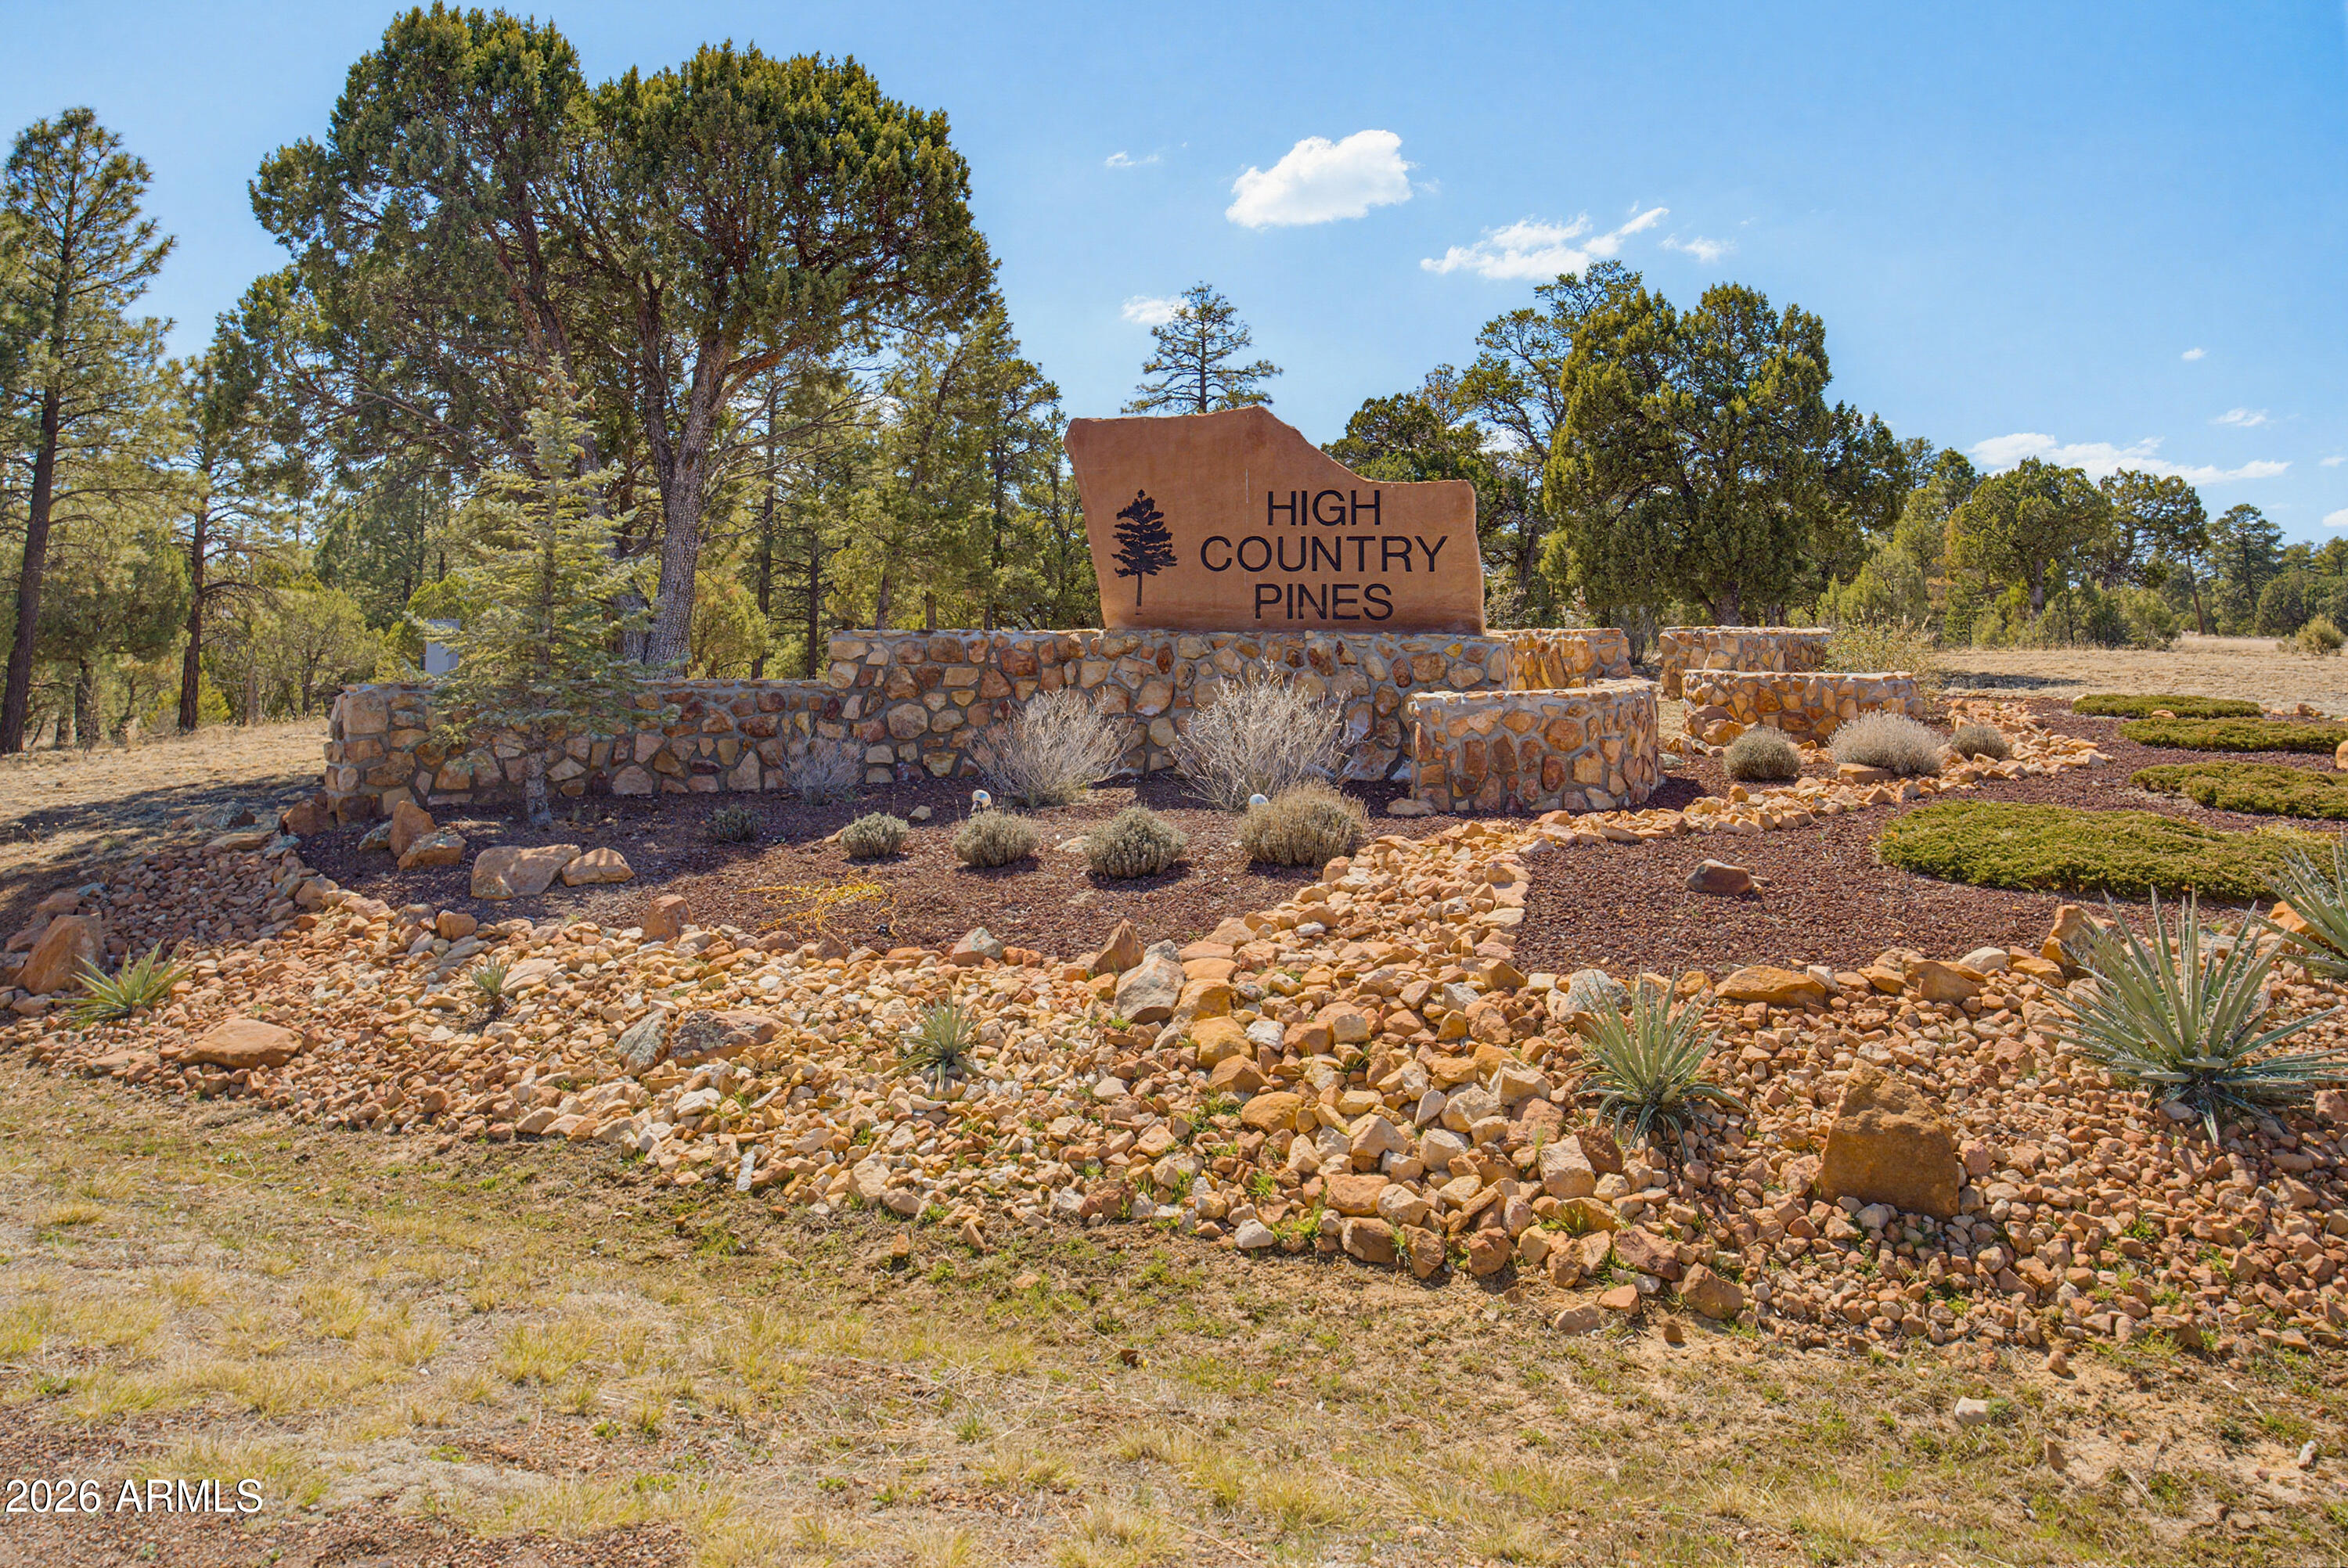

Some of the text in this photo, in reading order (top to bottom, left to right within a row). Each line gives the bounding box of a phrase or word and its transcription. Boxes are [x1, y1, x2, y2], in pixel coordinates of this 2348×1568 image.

[1266, 489, 1381, 527] HIGH
[1199, 535, 1448, 573] COUNTRY
[1255, 583, 1394, 620] PINES
